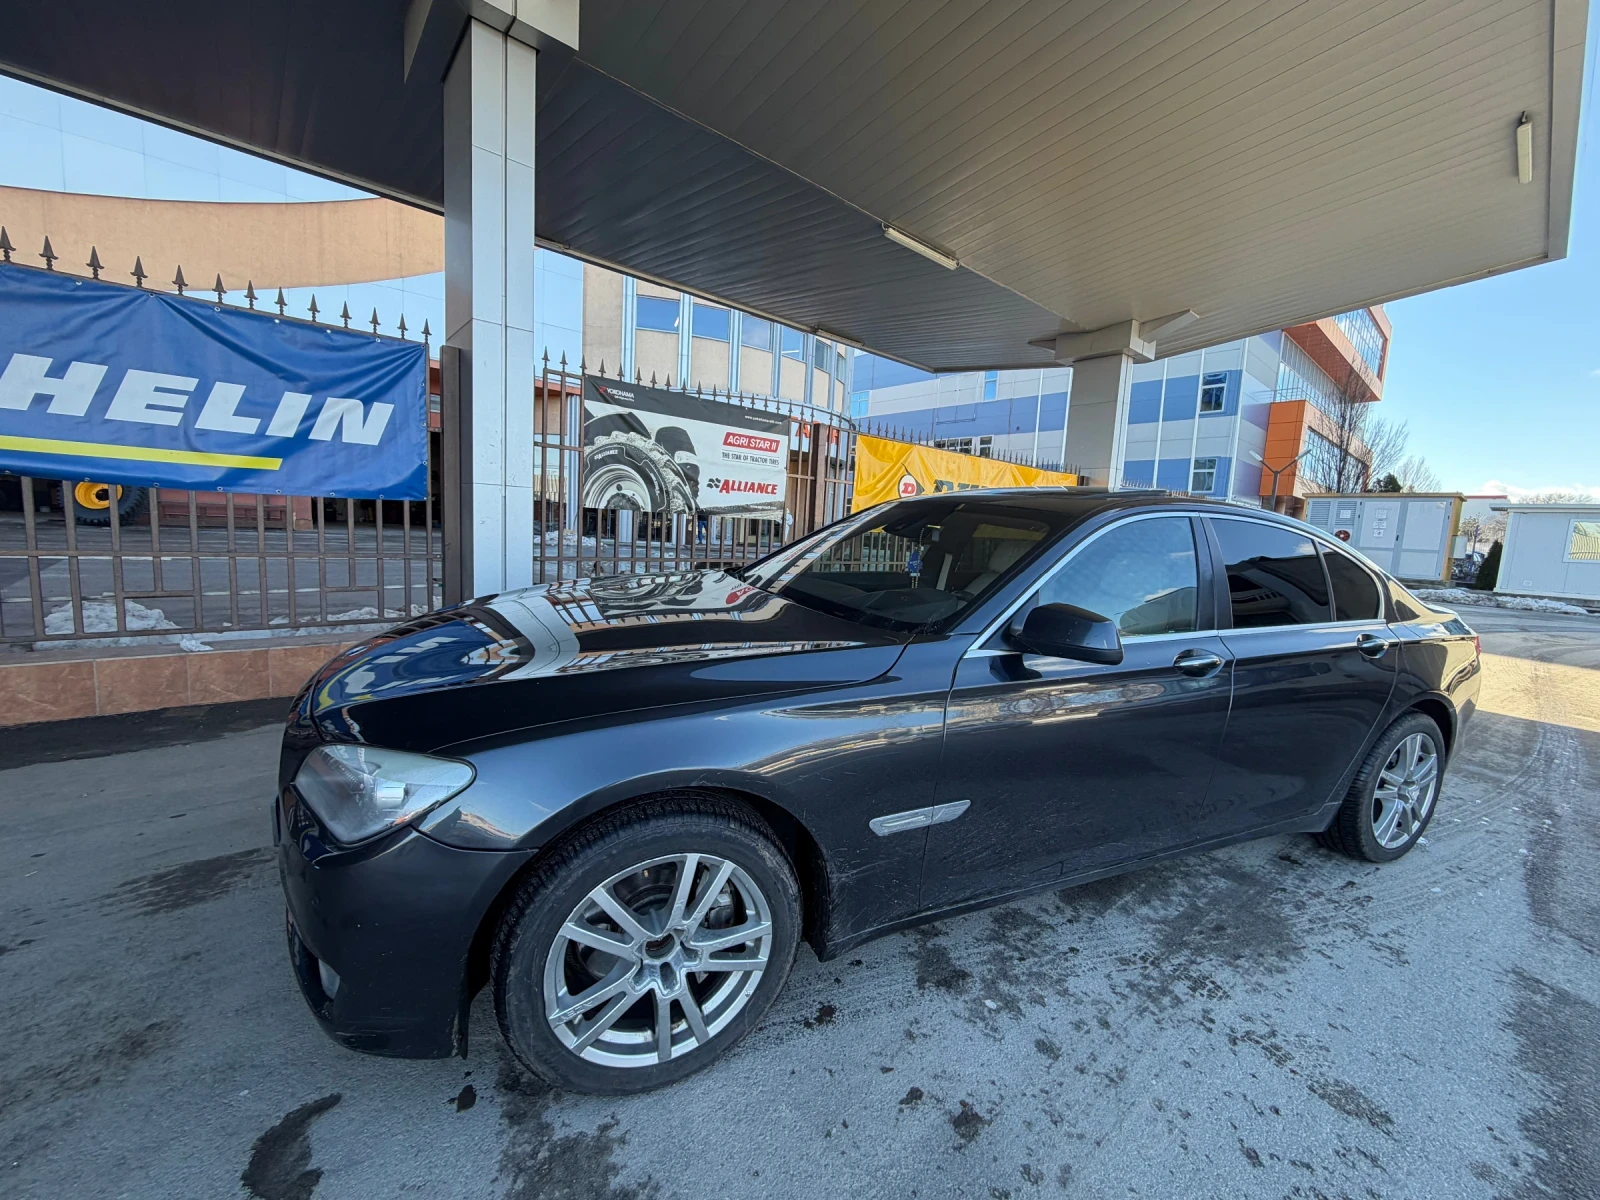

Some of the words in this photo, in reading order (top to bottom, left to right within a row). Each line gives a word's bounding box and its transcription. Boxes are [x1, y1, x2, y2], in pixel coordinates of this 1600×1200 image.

[0, 353, 394, 446] HELIN
[607, 388, 635, 398] YOKOHAMA
[727, 435, 749, 446] AGRI
[750, 438, 770, 450] STAR
[771, 441, 777, 450] II
[722, 451, 730, 460] THE
[750, 456, 768, 464] TRACTOR
[719, 479, 778, 495] ALLIANCE
[901, 482, 916, 494] D
